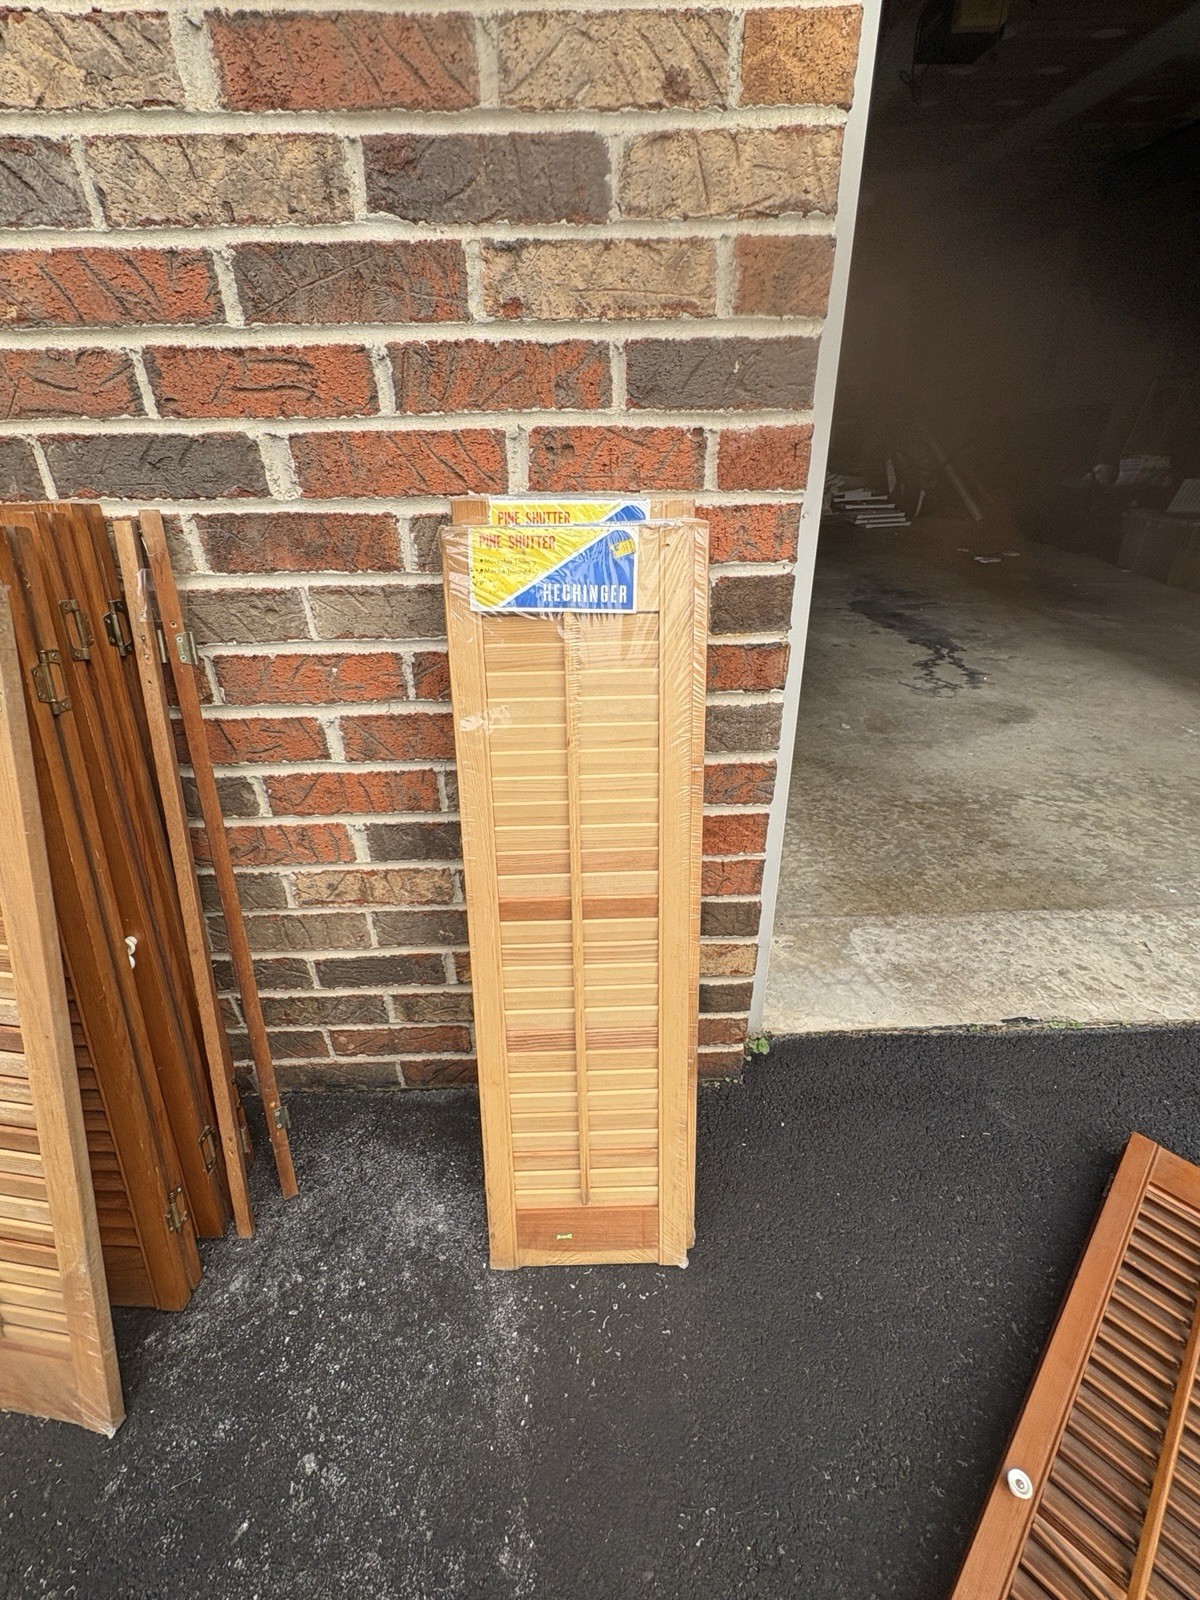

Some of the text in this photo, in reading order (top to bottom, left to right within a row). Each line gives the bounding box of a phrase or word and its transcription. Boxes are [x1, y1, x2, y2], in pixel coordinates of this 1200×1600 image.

[498, 511, 571, 525] PINE SHUTTER
[479, 534, 556, 549] PINE SHUTTER
[543, 583, 628, 604] HECHINGER
